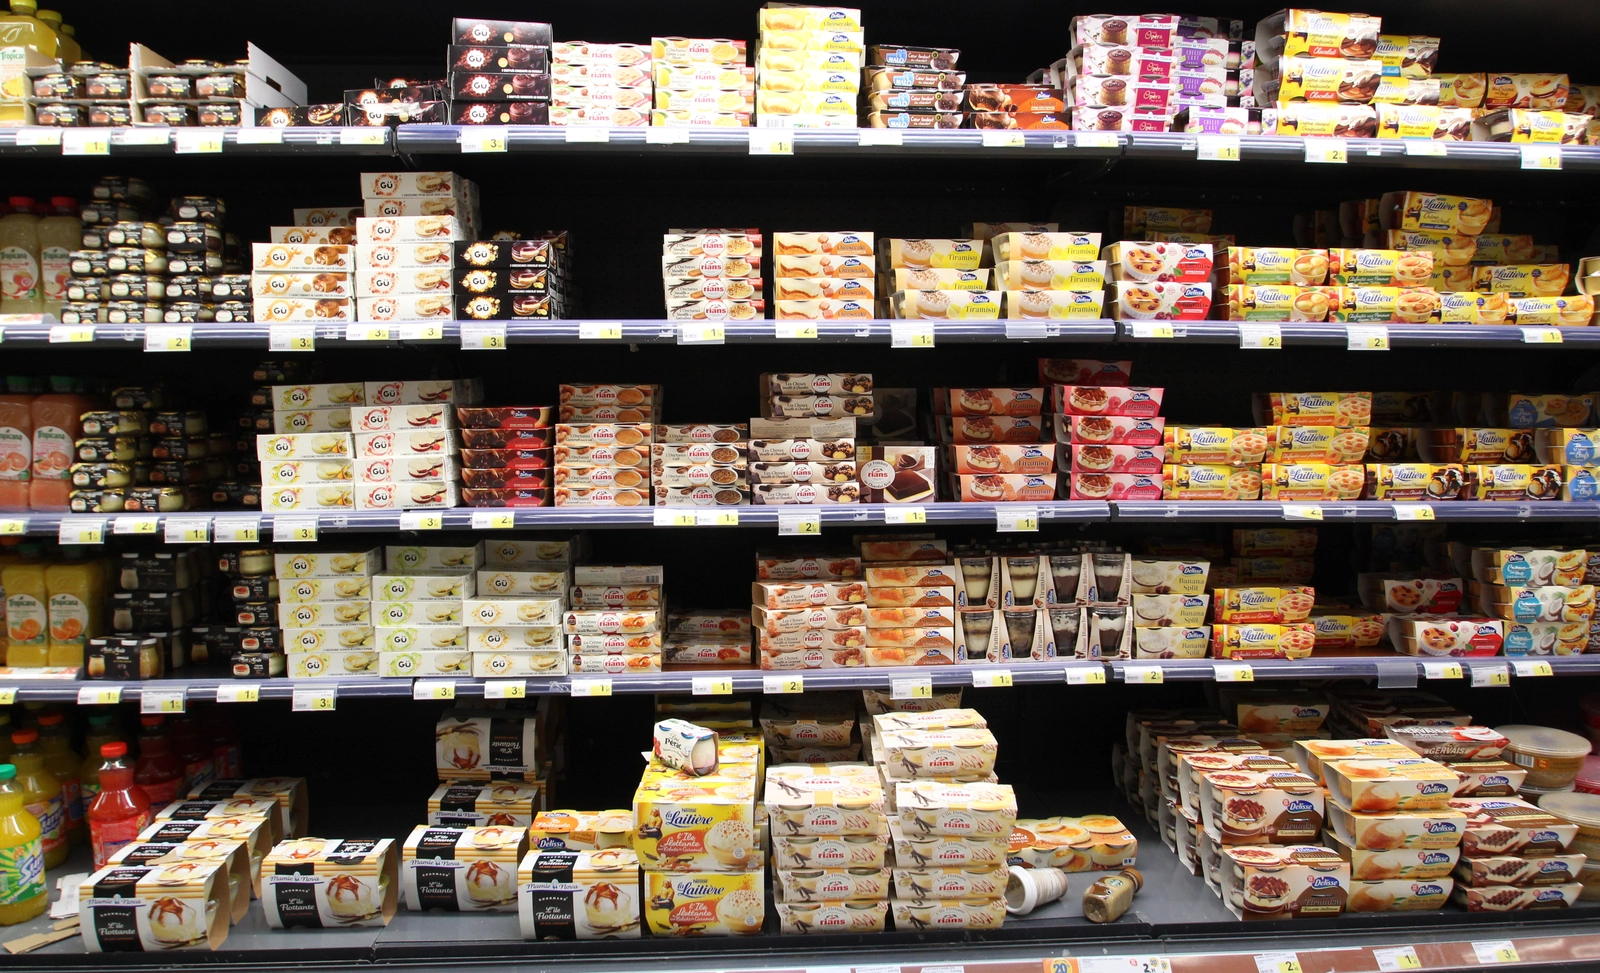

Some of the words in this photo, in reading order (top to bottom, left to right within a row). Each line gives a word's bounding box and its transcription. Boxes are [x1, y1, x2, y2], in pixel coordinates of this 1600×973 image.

[1313, 47, 1336, 55] Chocolat
[948, 253, 977, 262] Tiramisu
[1302, 398, 1334, 408] Laitière
[1194, 435, 1228, 445] Laitière
[1295, 433, 1329, 445] Laitière
[1192, 472, 1225, 483] Laitière
[1291, 472, 1324, 483] Laitière
[1244, 594, 1276, 605] Laitière
[1319, 622, 1349, 632] Laitière
[1244, 631, 1276, 642] Laitière
[1428, 747, 1466, 755] GERVAIS
[1289, 802, 1312, 811] Delisse
[666, 812, 714, 827] Laitière
[539, 840, 564, 848] Delisse
[1314, 879, 1337, 887] Delisse
[678, 883, 724, 898] Laitière
[1053, 963, 1067, 973] 20
